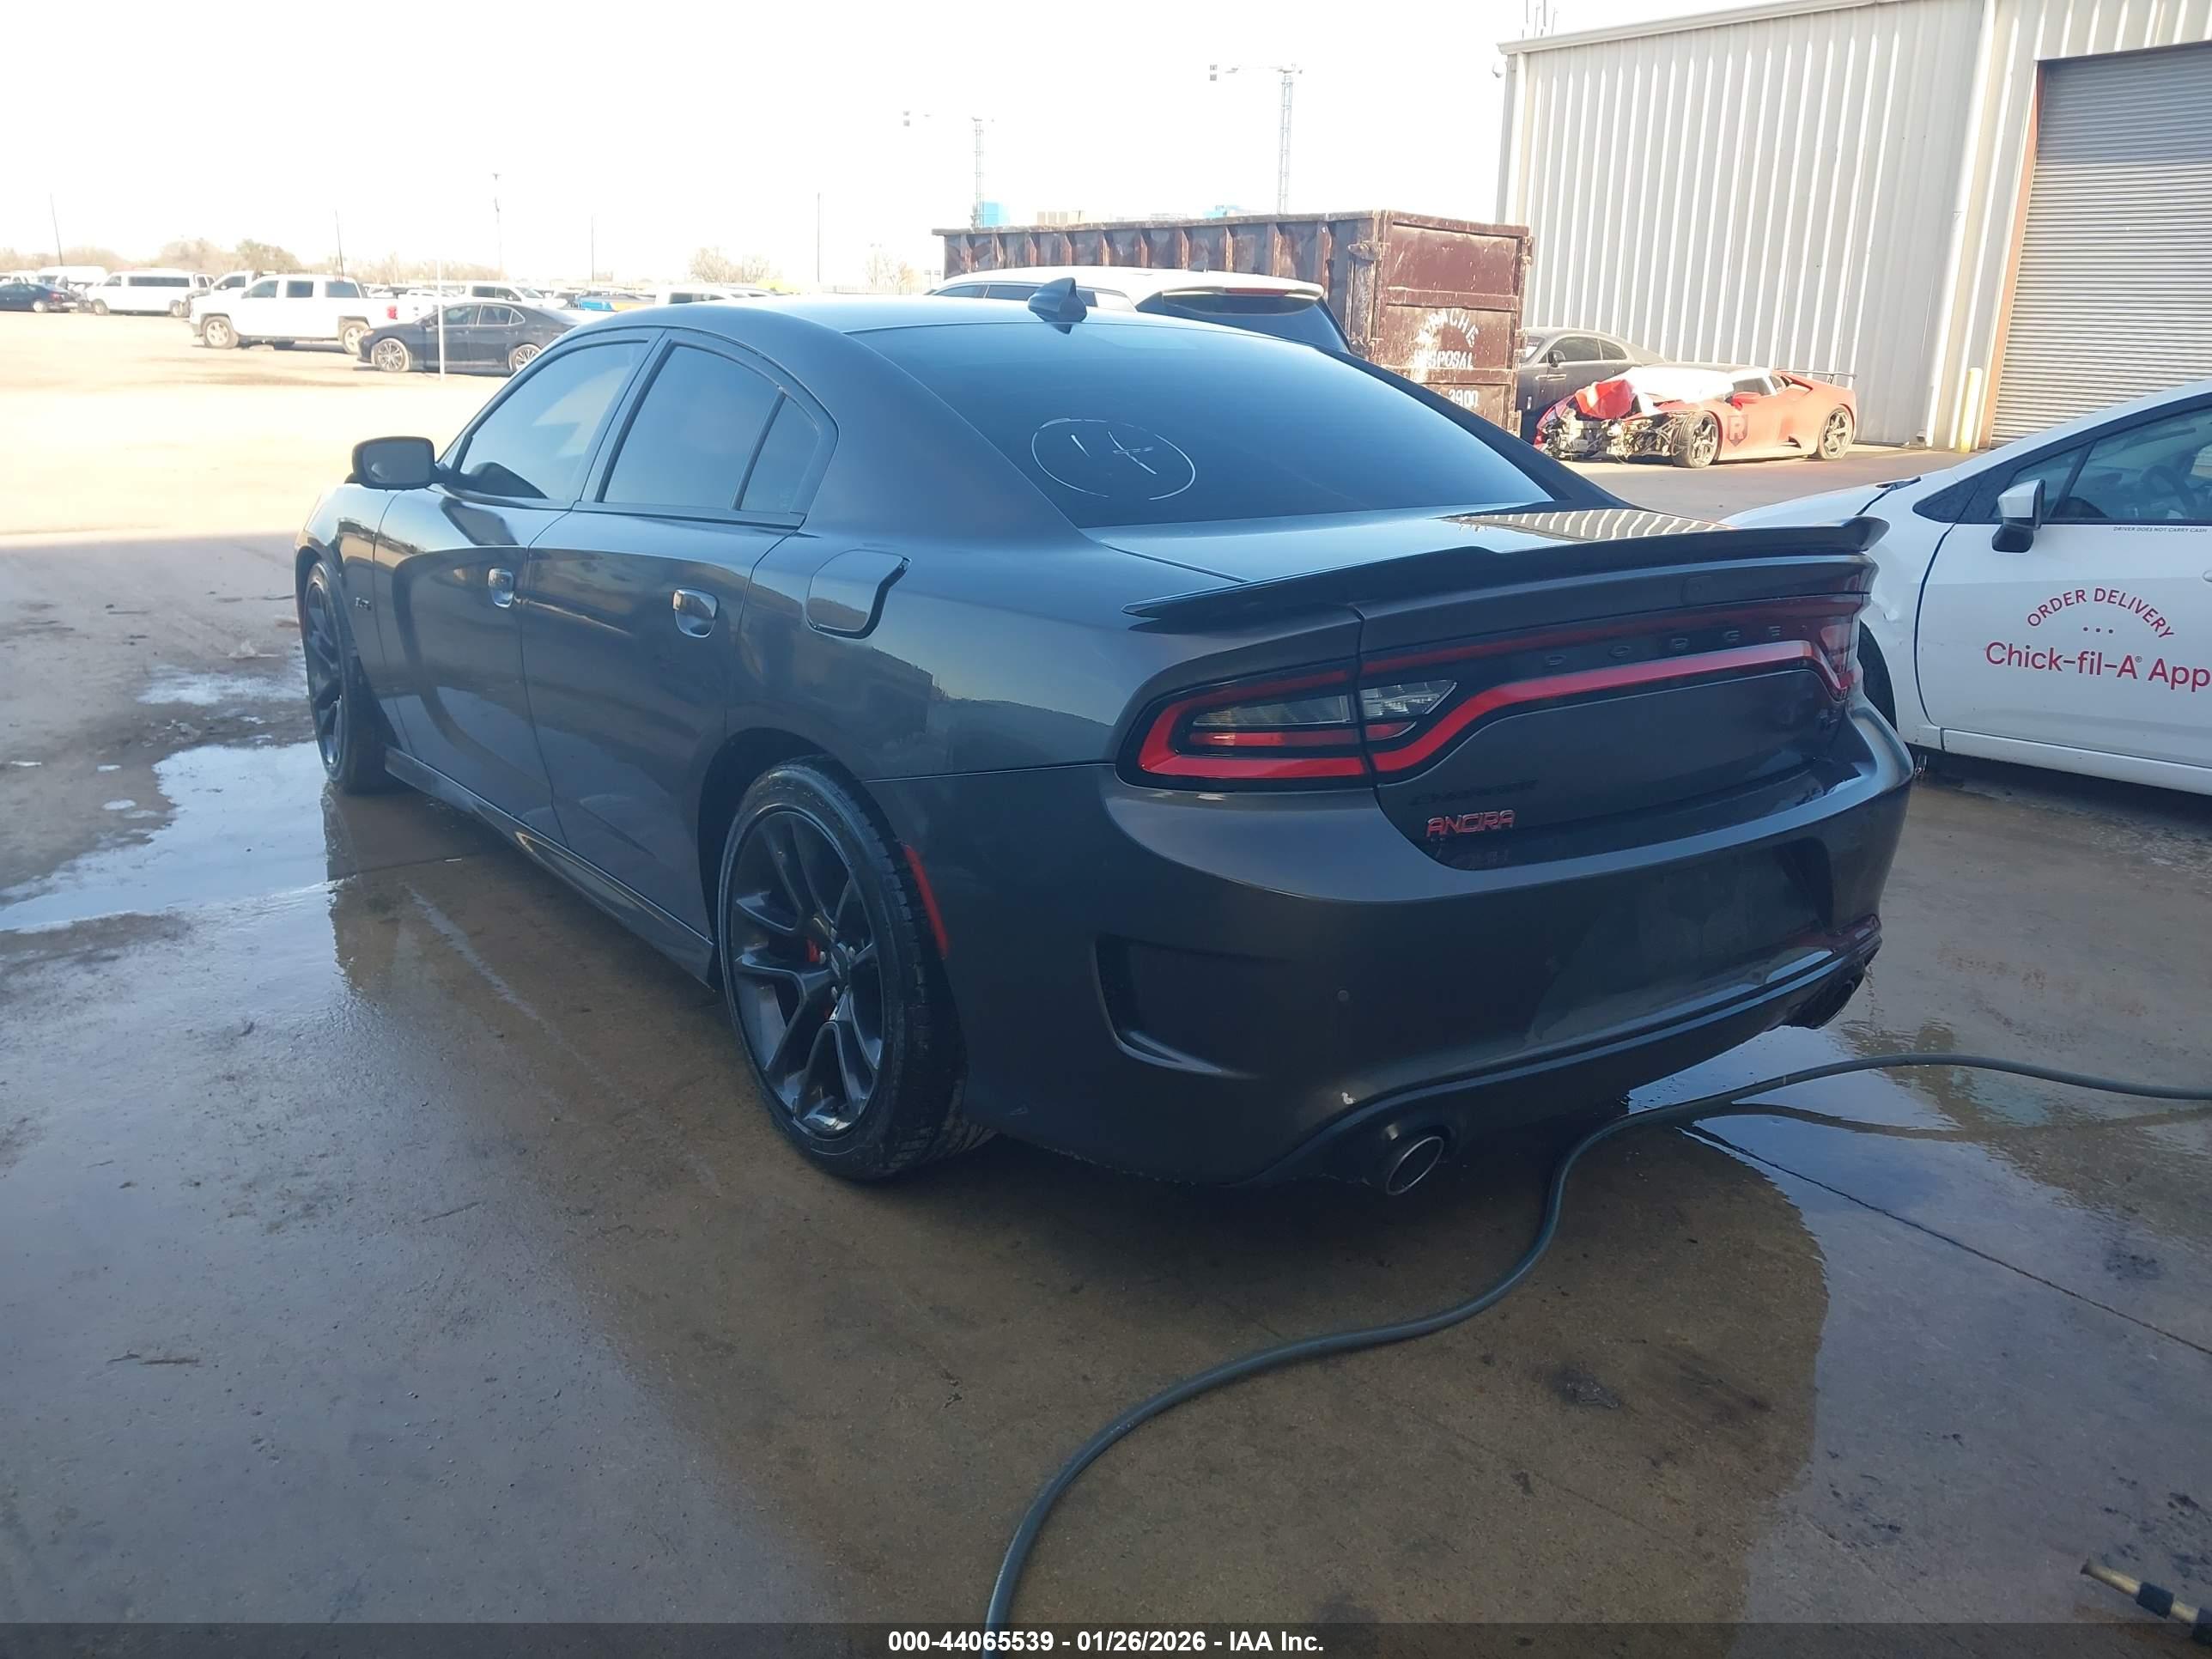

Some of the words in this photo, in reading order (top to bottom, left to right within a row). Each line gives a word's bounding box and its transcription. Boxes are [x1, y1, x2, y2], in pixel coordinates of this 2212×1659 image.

[2027, 589, 2087, 626] ORDER
[2094, 587, 2175, 639] DELIVERY
[2148, 658, 2212, 692] App
[1425, 809, 1516, 838] ANCIRA
